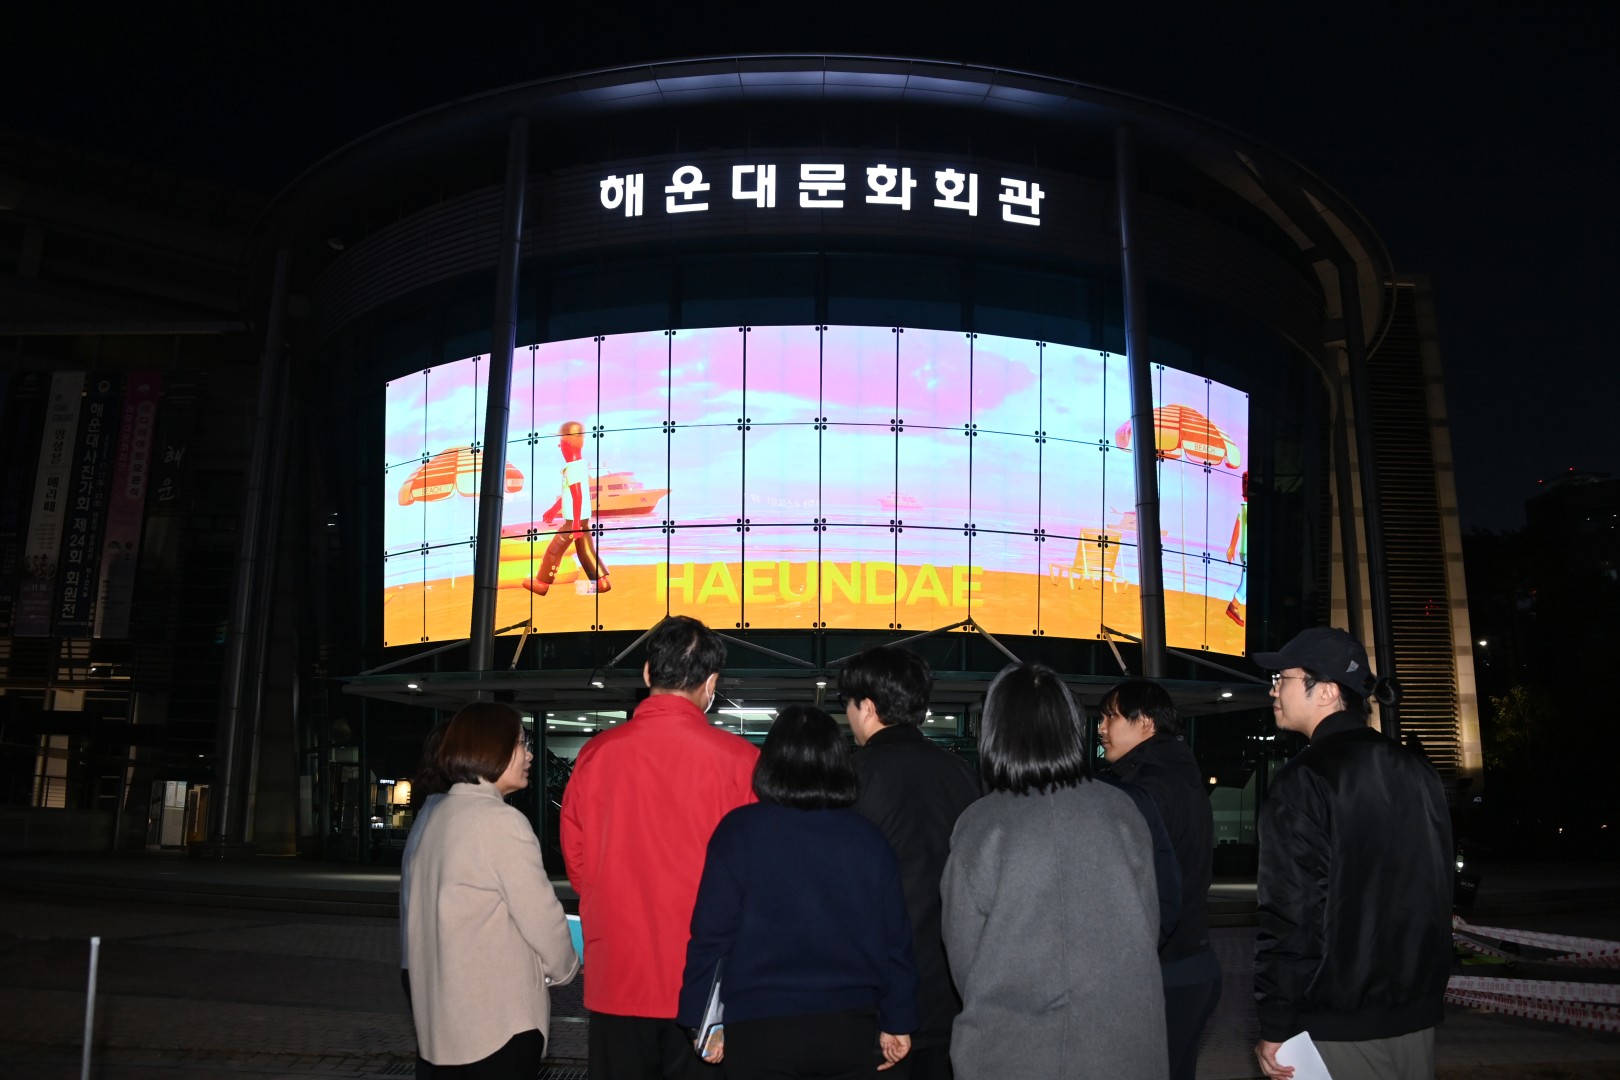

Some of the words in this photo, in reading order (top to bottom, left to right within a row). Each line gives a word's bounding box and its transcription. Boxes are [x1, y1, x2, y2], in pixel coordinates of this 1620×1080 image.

[600, 163, 1046, 226] 해운대문화회관
[75, 402, 104, 511] 해운대사진가회
[67, 517, 88, 563] 제24회
[62, 571, 80, 619] 회원전
[655, 560, 984, 607] HAEUNDAE
